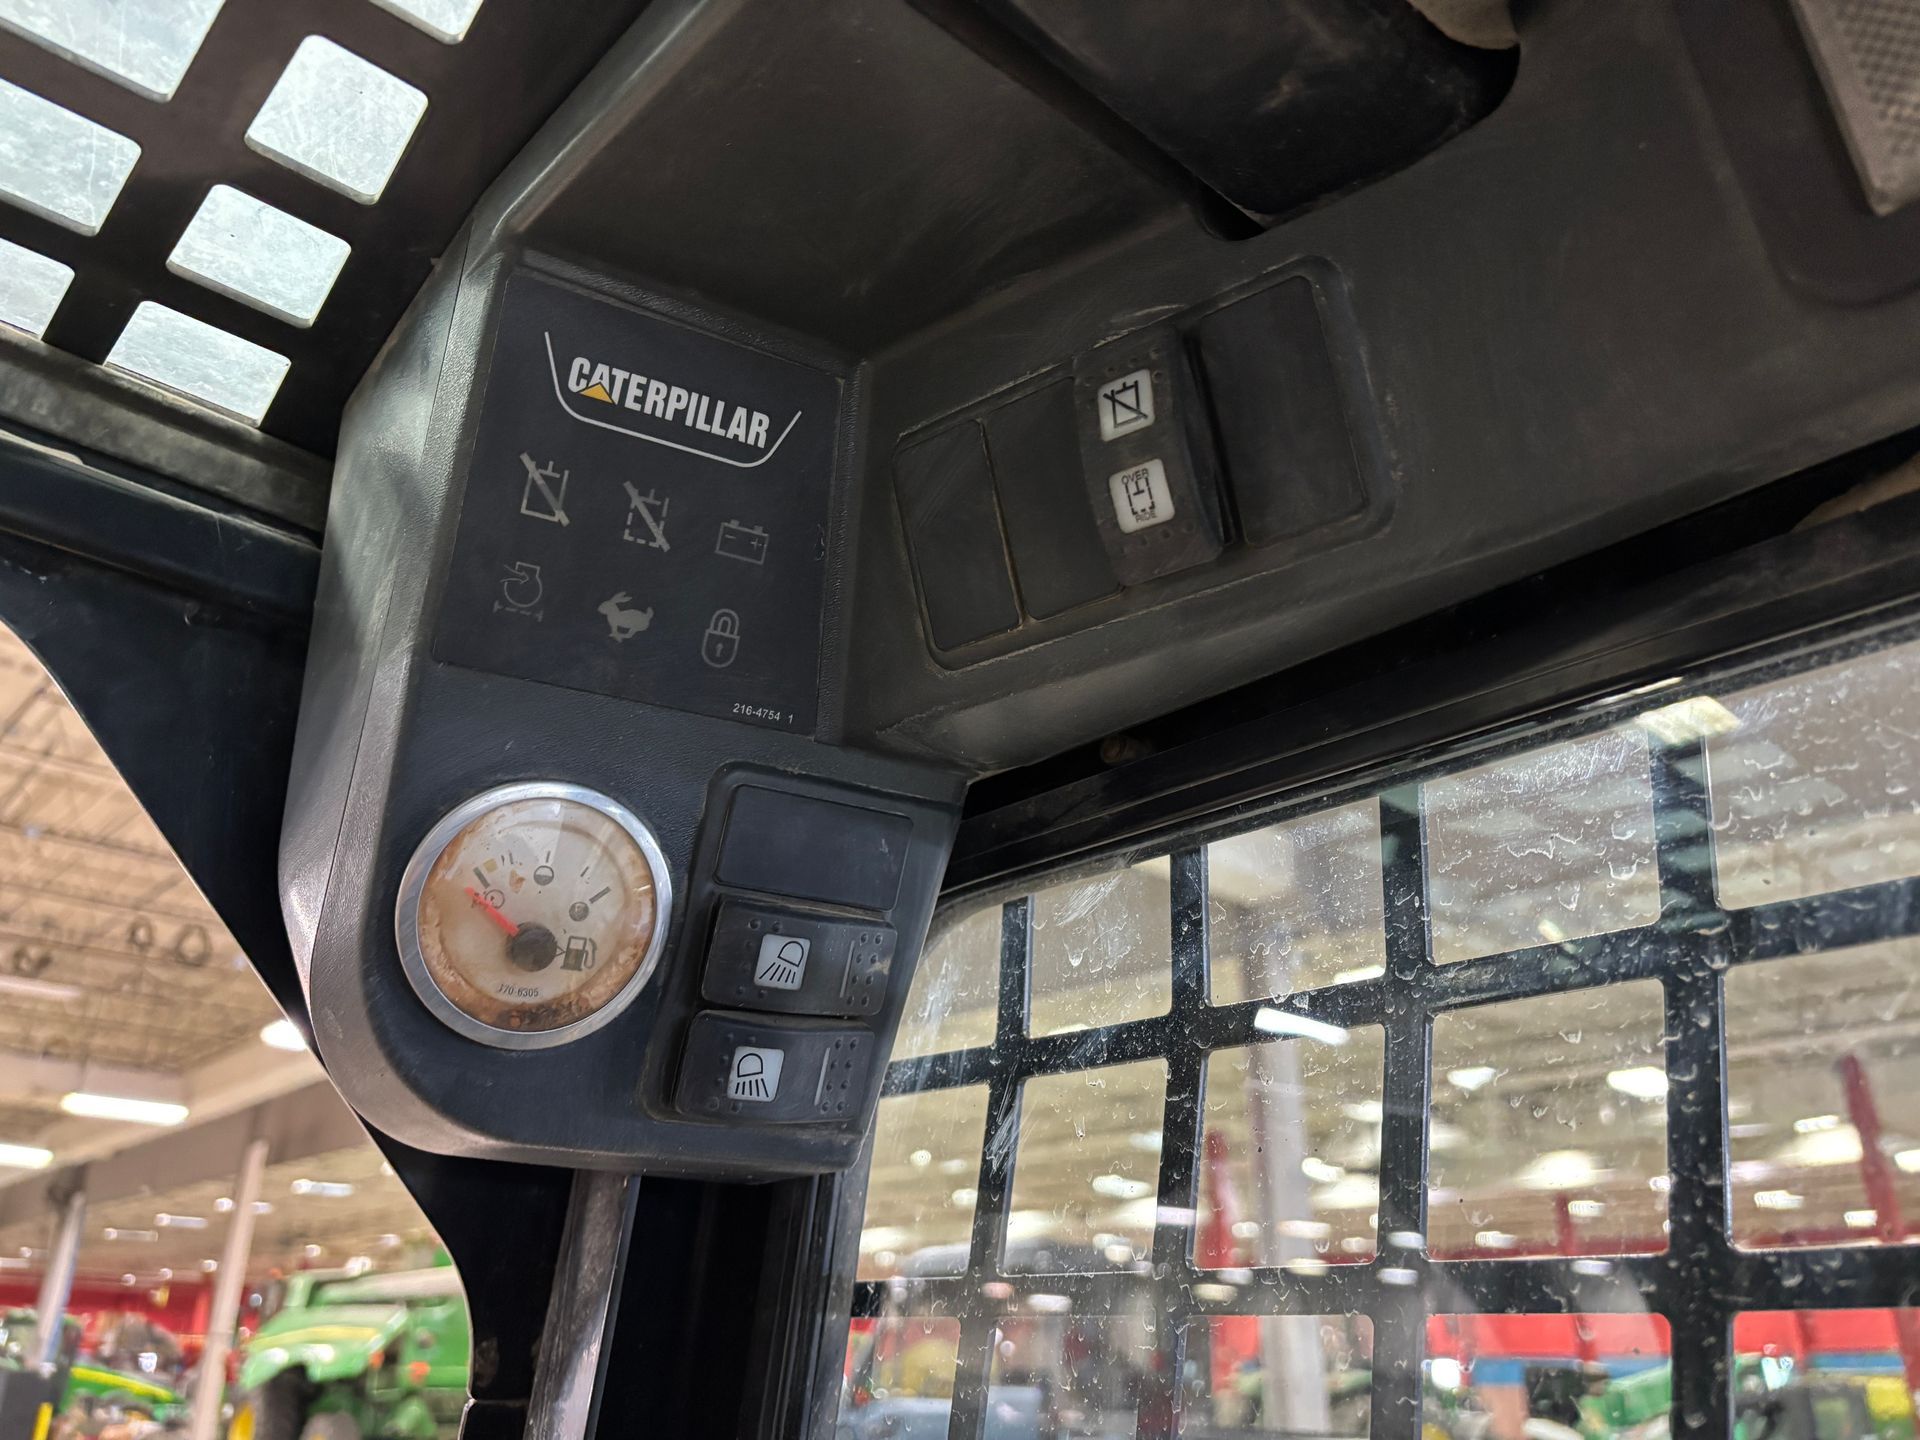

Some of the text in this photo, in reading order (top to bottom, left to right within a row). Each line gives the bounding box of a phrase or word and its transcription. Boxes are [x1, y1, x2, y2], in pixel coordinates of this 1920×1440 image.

[567, 356, 770, 449] CATERPILLAR
[1121, 468, 1149, 485] OVER
[1135, 510, 1157, 523] RIDE
[733, 703, 781, 721] 216-4754
